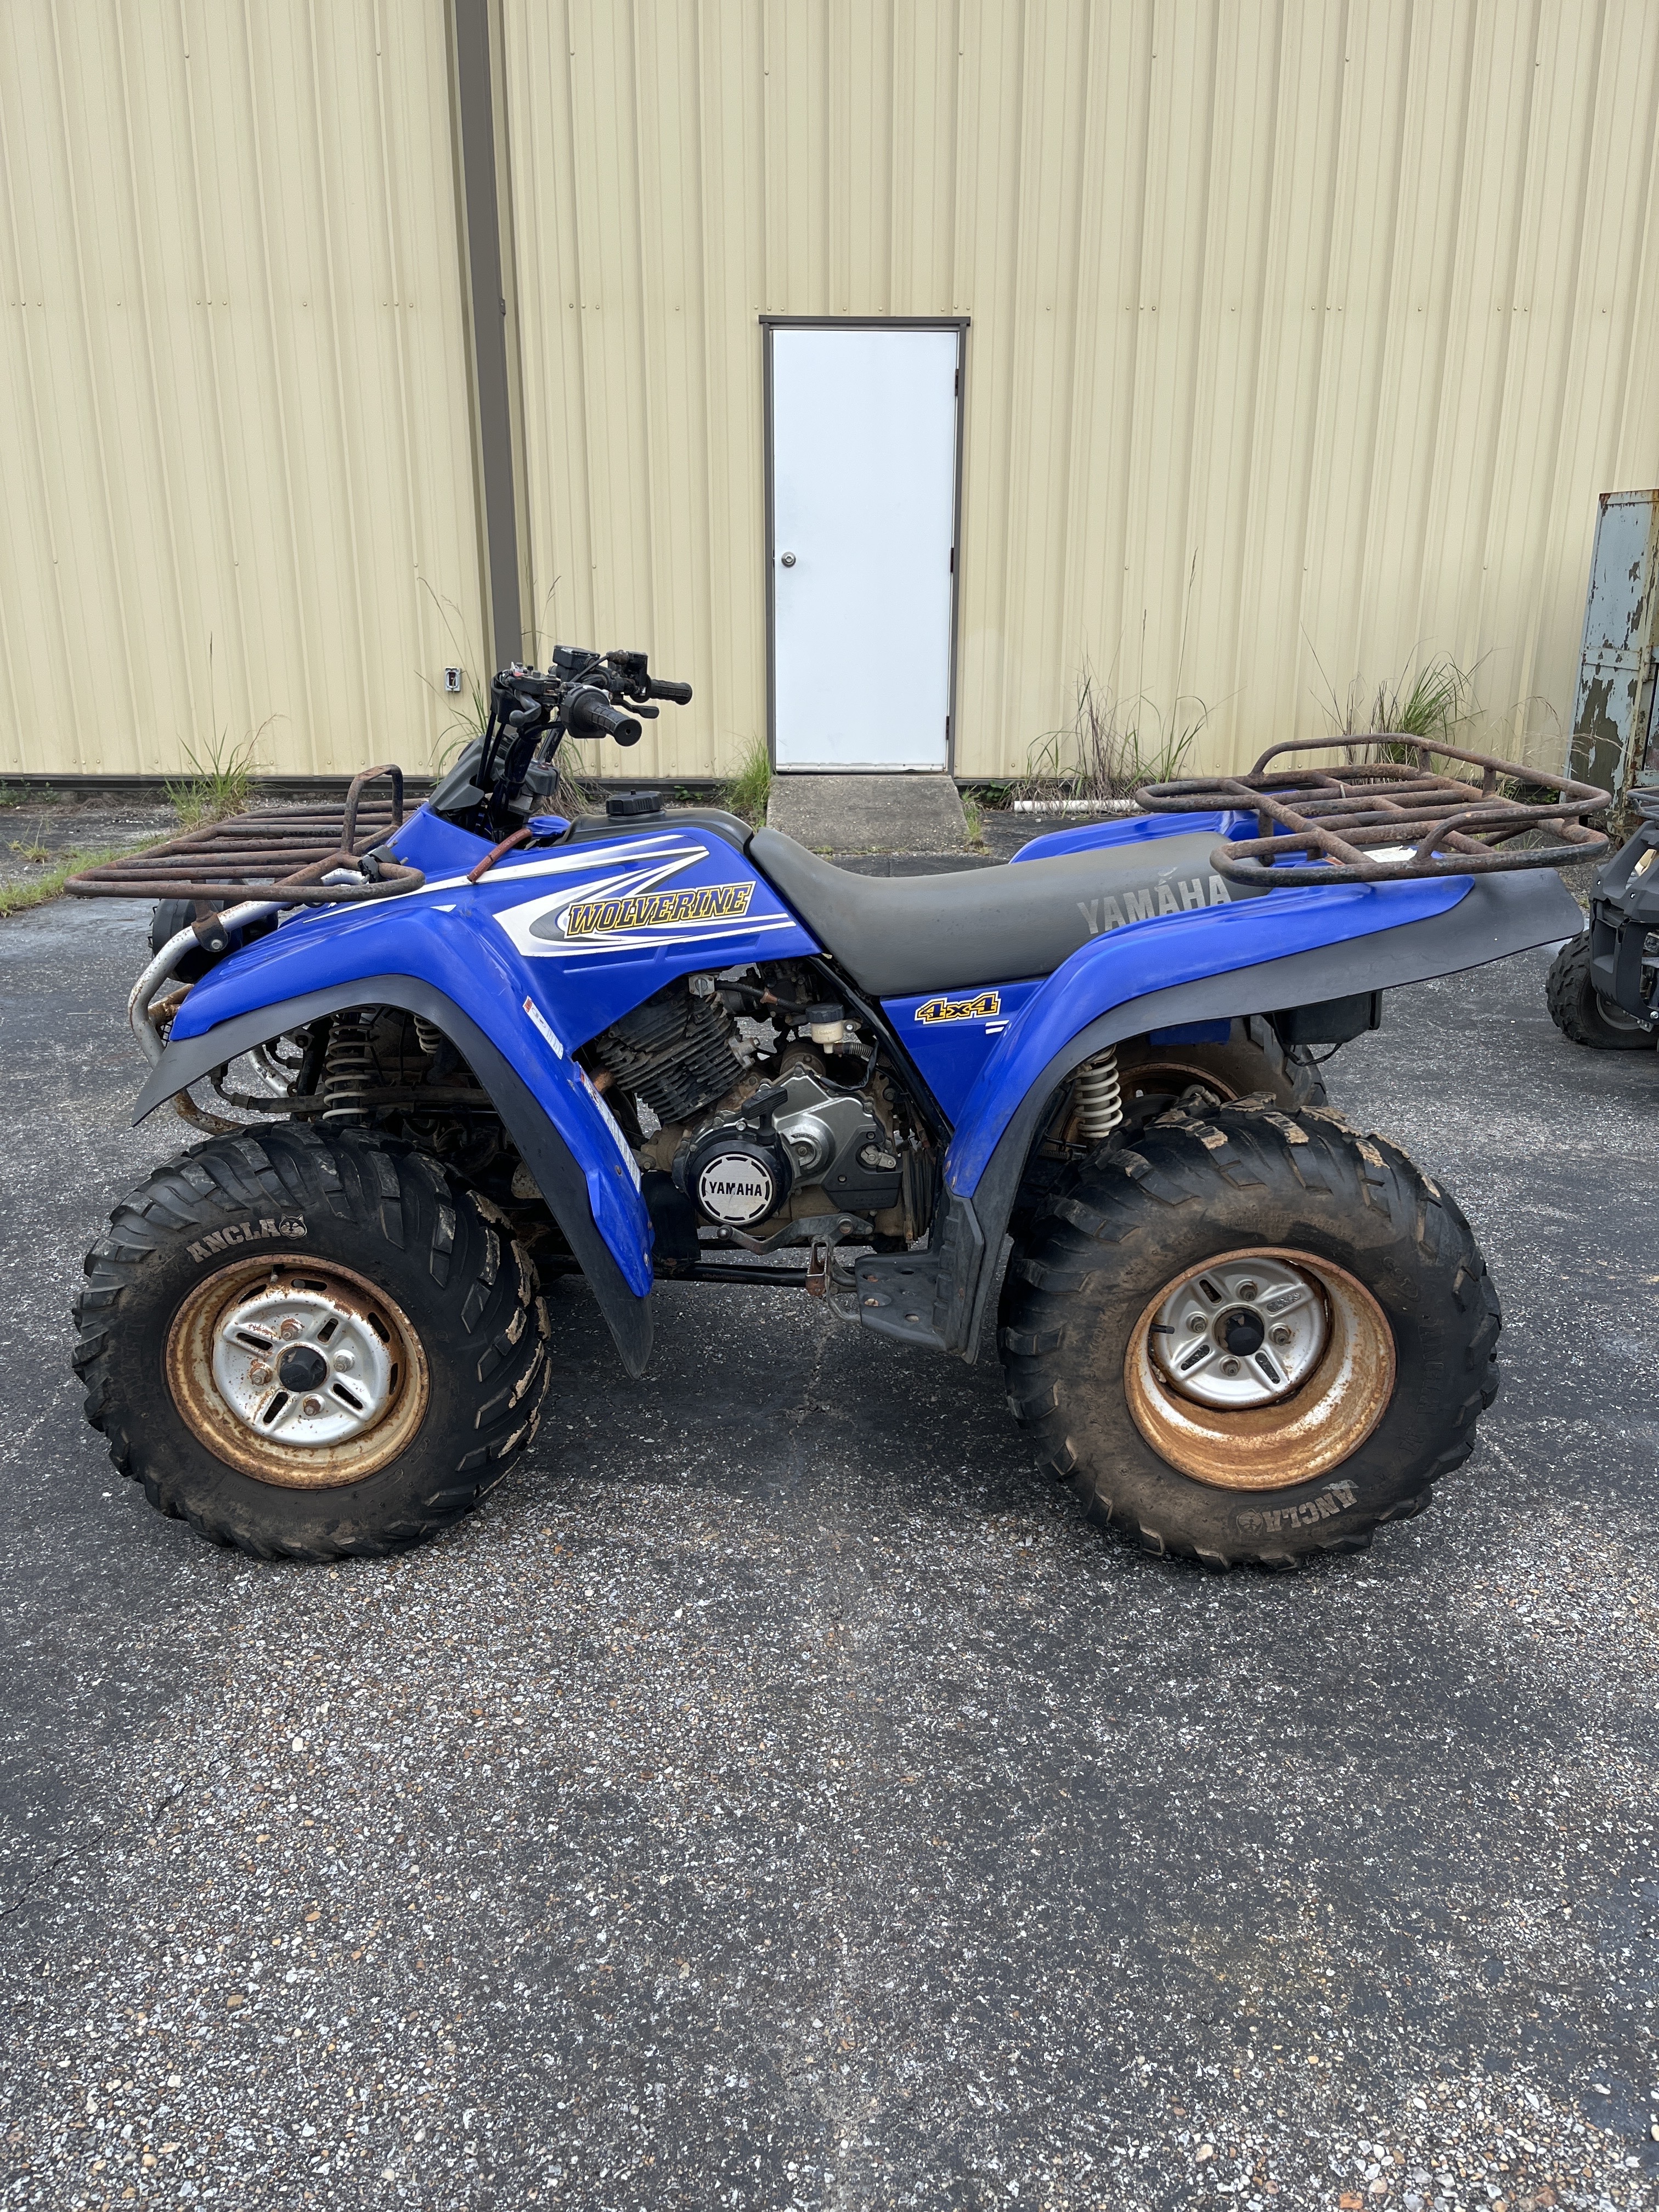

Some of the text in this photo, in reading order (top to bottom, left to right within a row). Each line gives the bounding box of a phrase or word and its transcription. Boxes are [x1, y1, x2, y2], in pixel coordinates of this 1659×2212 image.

[567, 884, 753, 936] WOLVERINE
[1076, 874, 1232, 934] YAMAHA
[917, 994, 998, 1022] 4x4
[709, 1181, 763, 1197] YAMAHA
[186, 1218, 281, 1263] ANCLA
[1262, 1482, 1358, 1532] ANCLA
